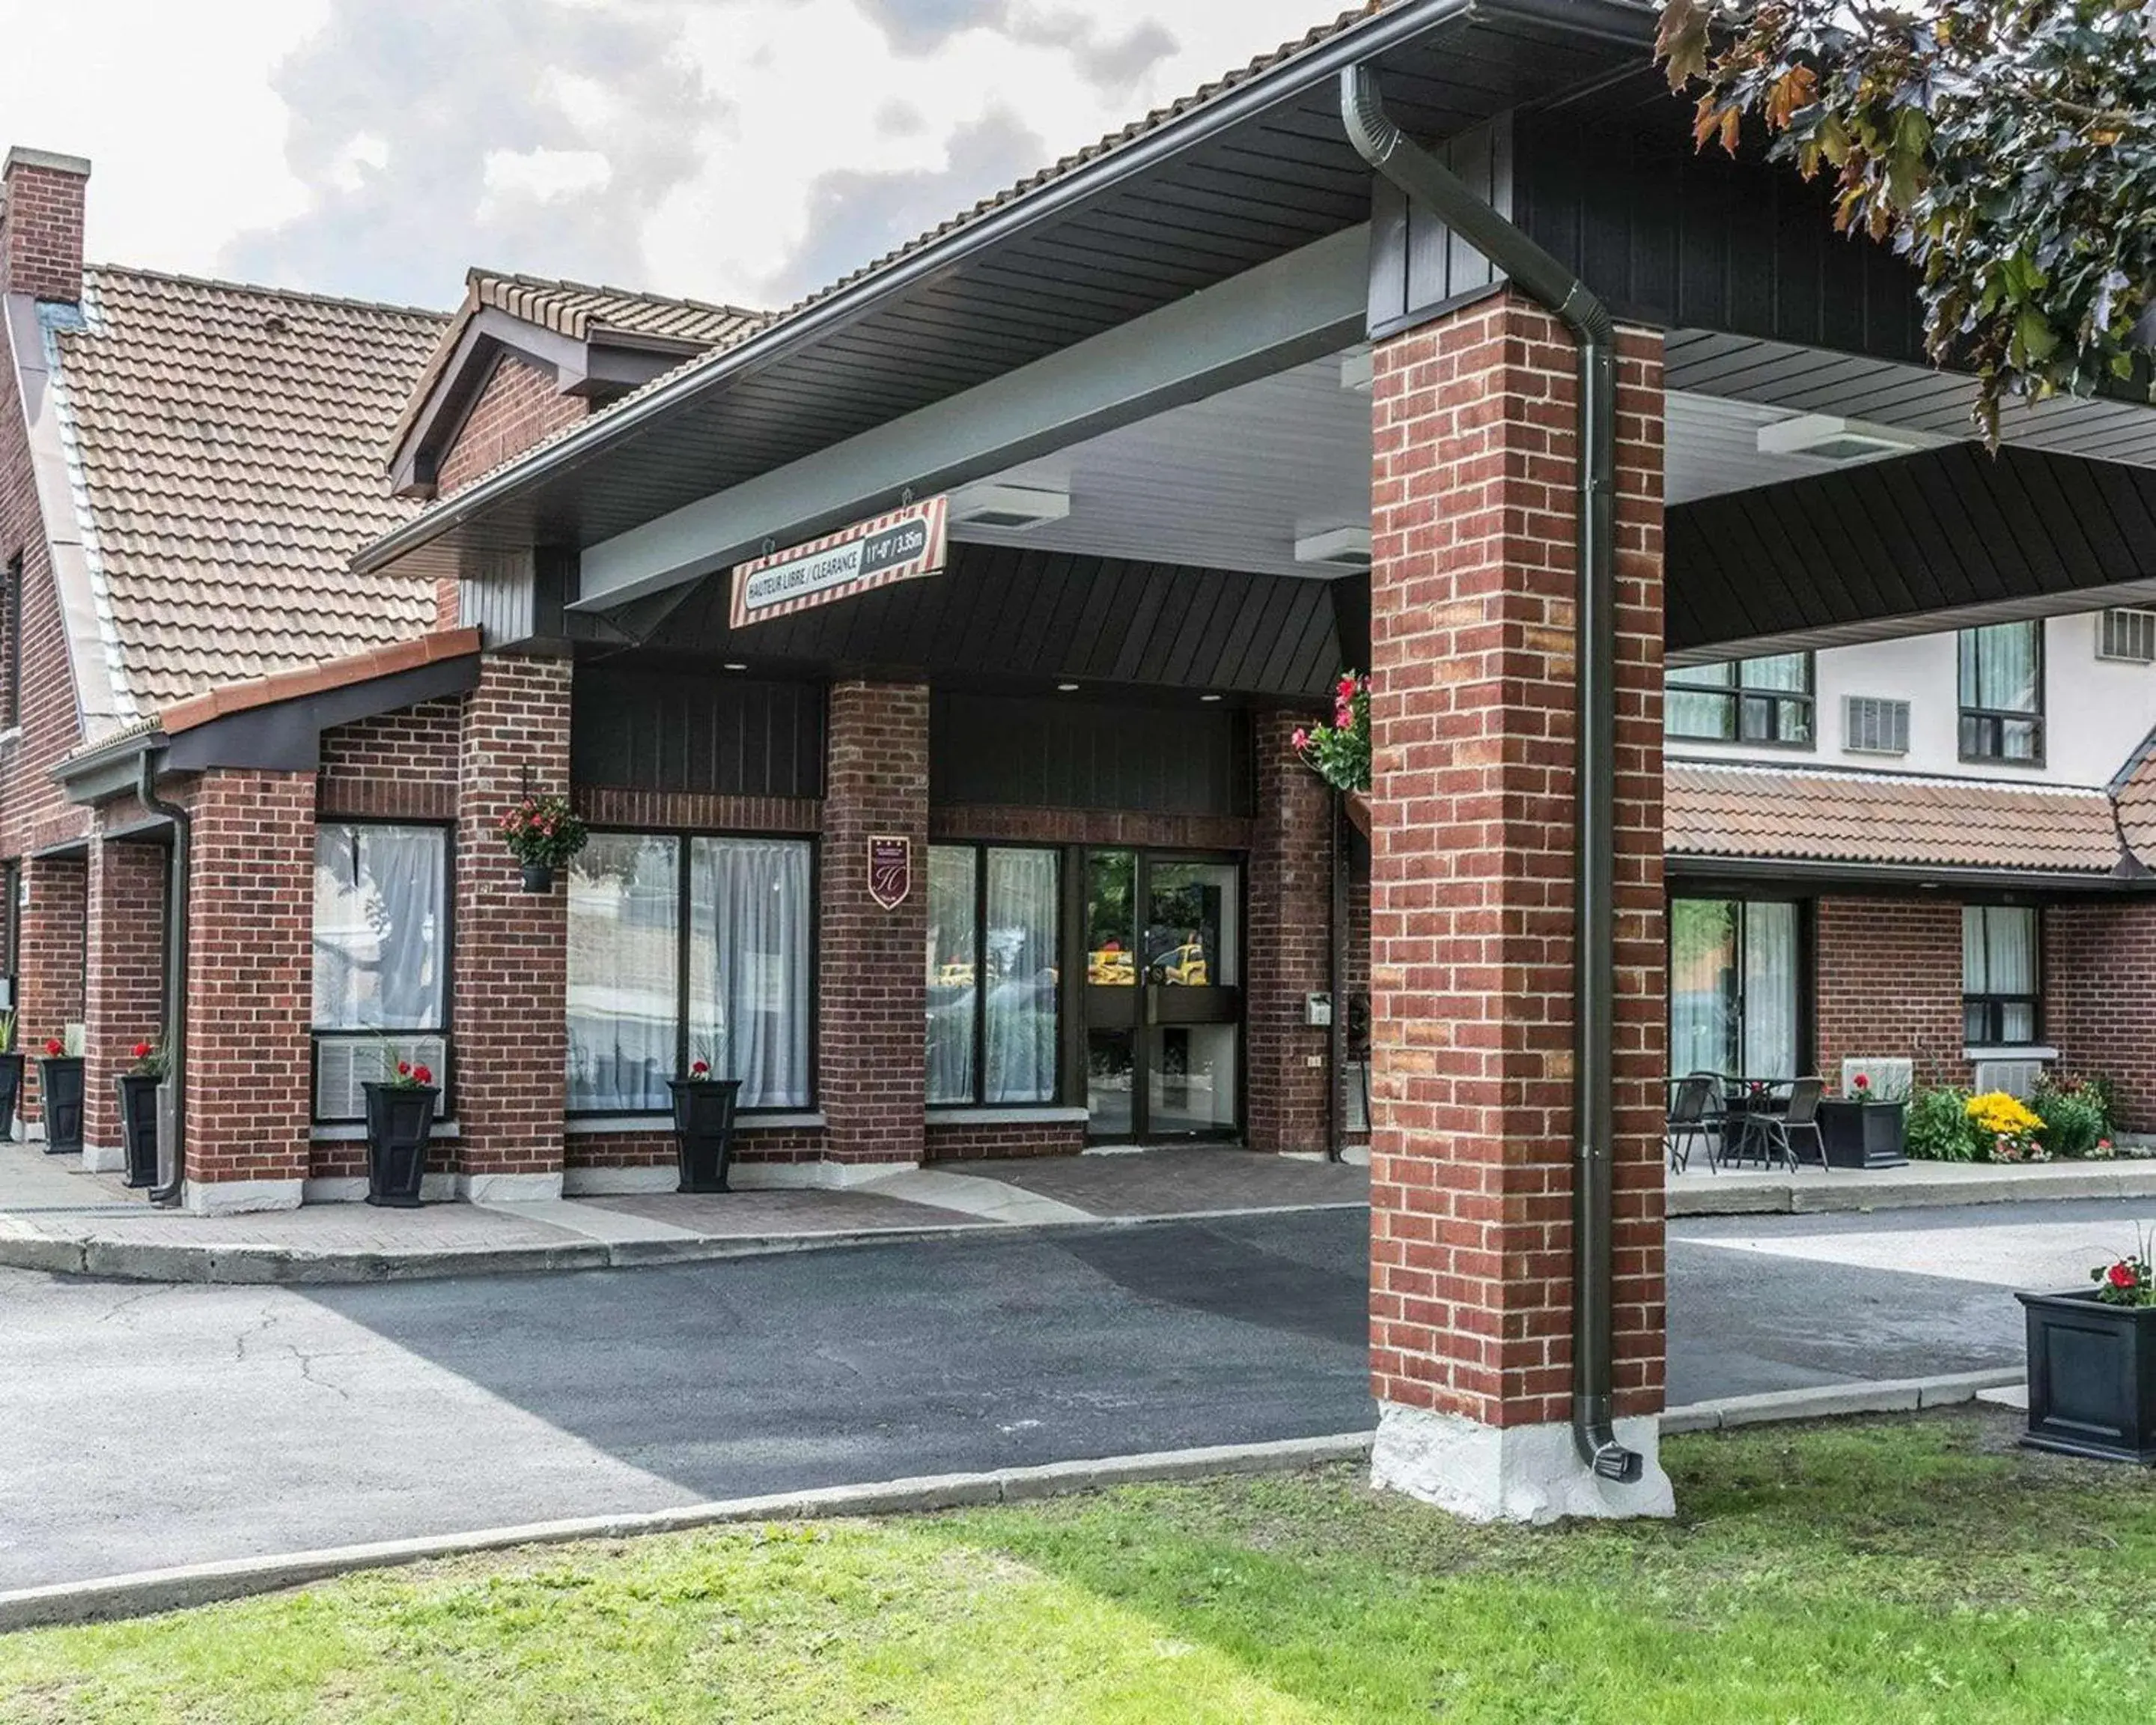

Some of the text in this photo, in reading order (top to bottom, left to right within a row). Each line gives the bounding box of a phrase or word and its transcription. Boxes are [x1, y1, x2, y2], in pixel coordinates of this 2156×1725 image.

[749, 576, 782, 598] HAUTEUR
[783, 568, 806, 589] LIBRE
[812, 551, 857, 580] CLEARANCE
